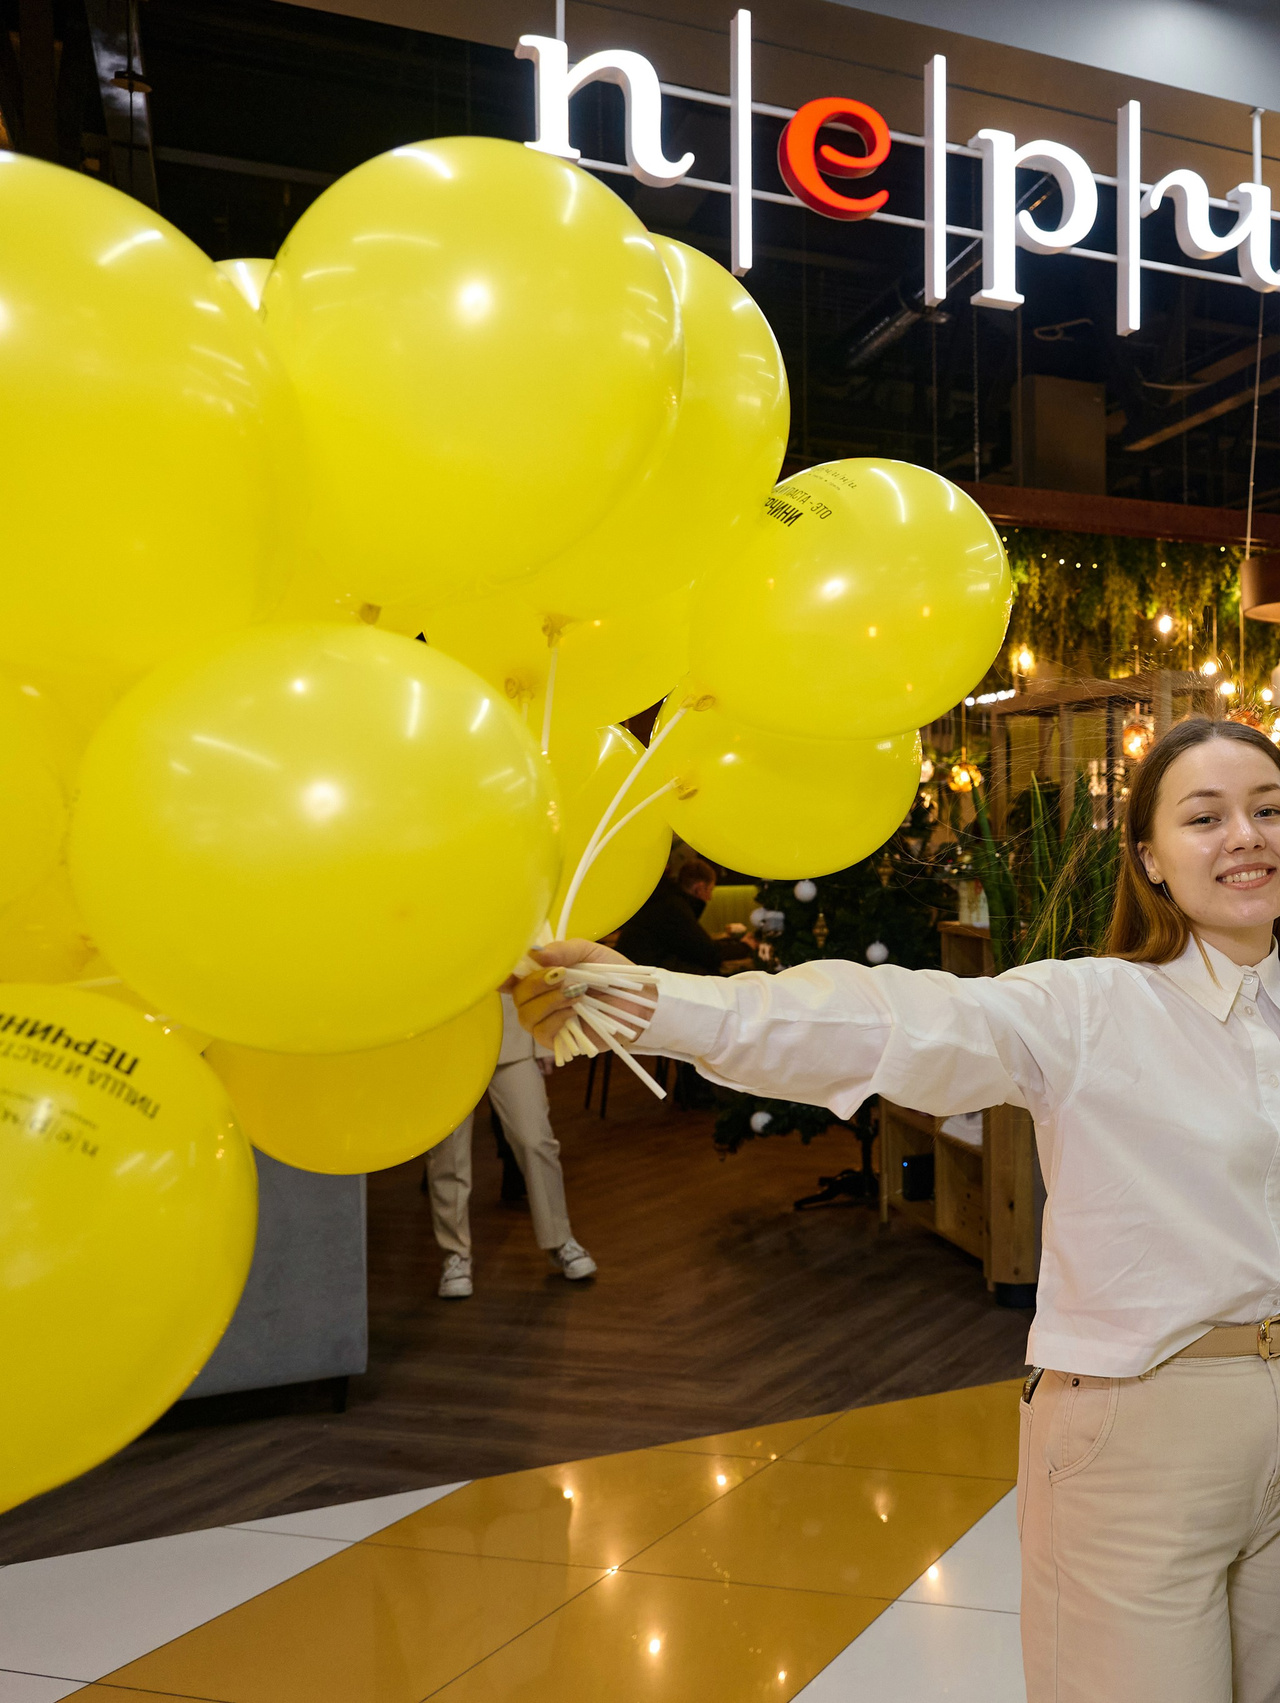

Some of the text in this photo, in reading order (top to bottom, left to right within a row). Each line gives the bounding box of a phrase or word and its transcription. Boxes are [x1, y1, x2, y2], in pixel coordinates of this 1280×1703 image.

[764, 496, 804, 527] РЧИНИ
[810, 502, 833, 520] ЭТО
[0, 1040, 64, 1071] ПАСТ
[87, 1067, 161, 1120] ПИЦЦА
